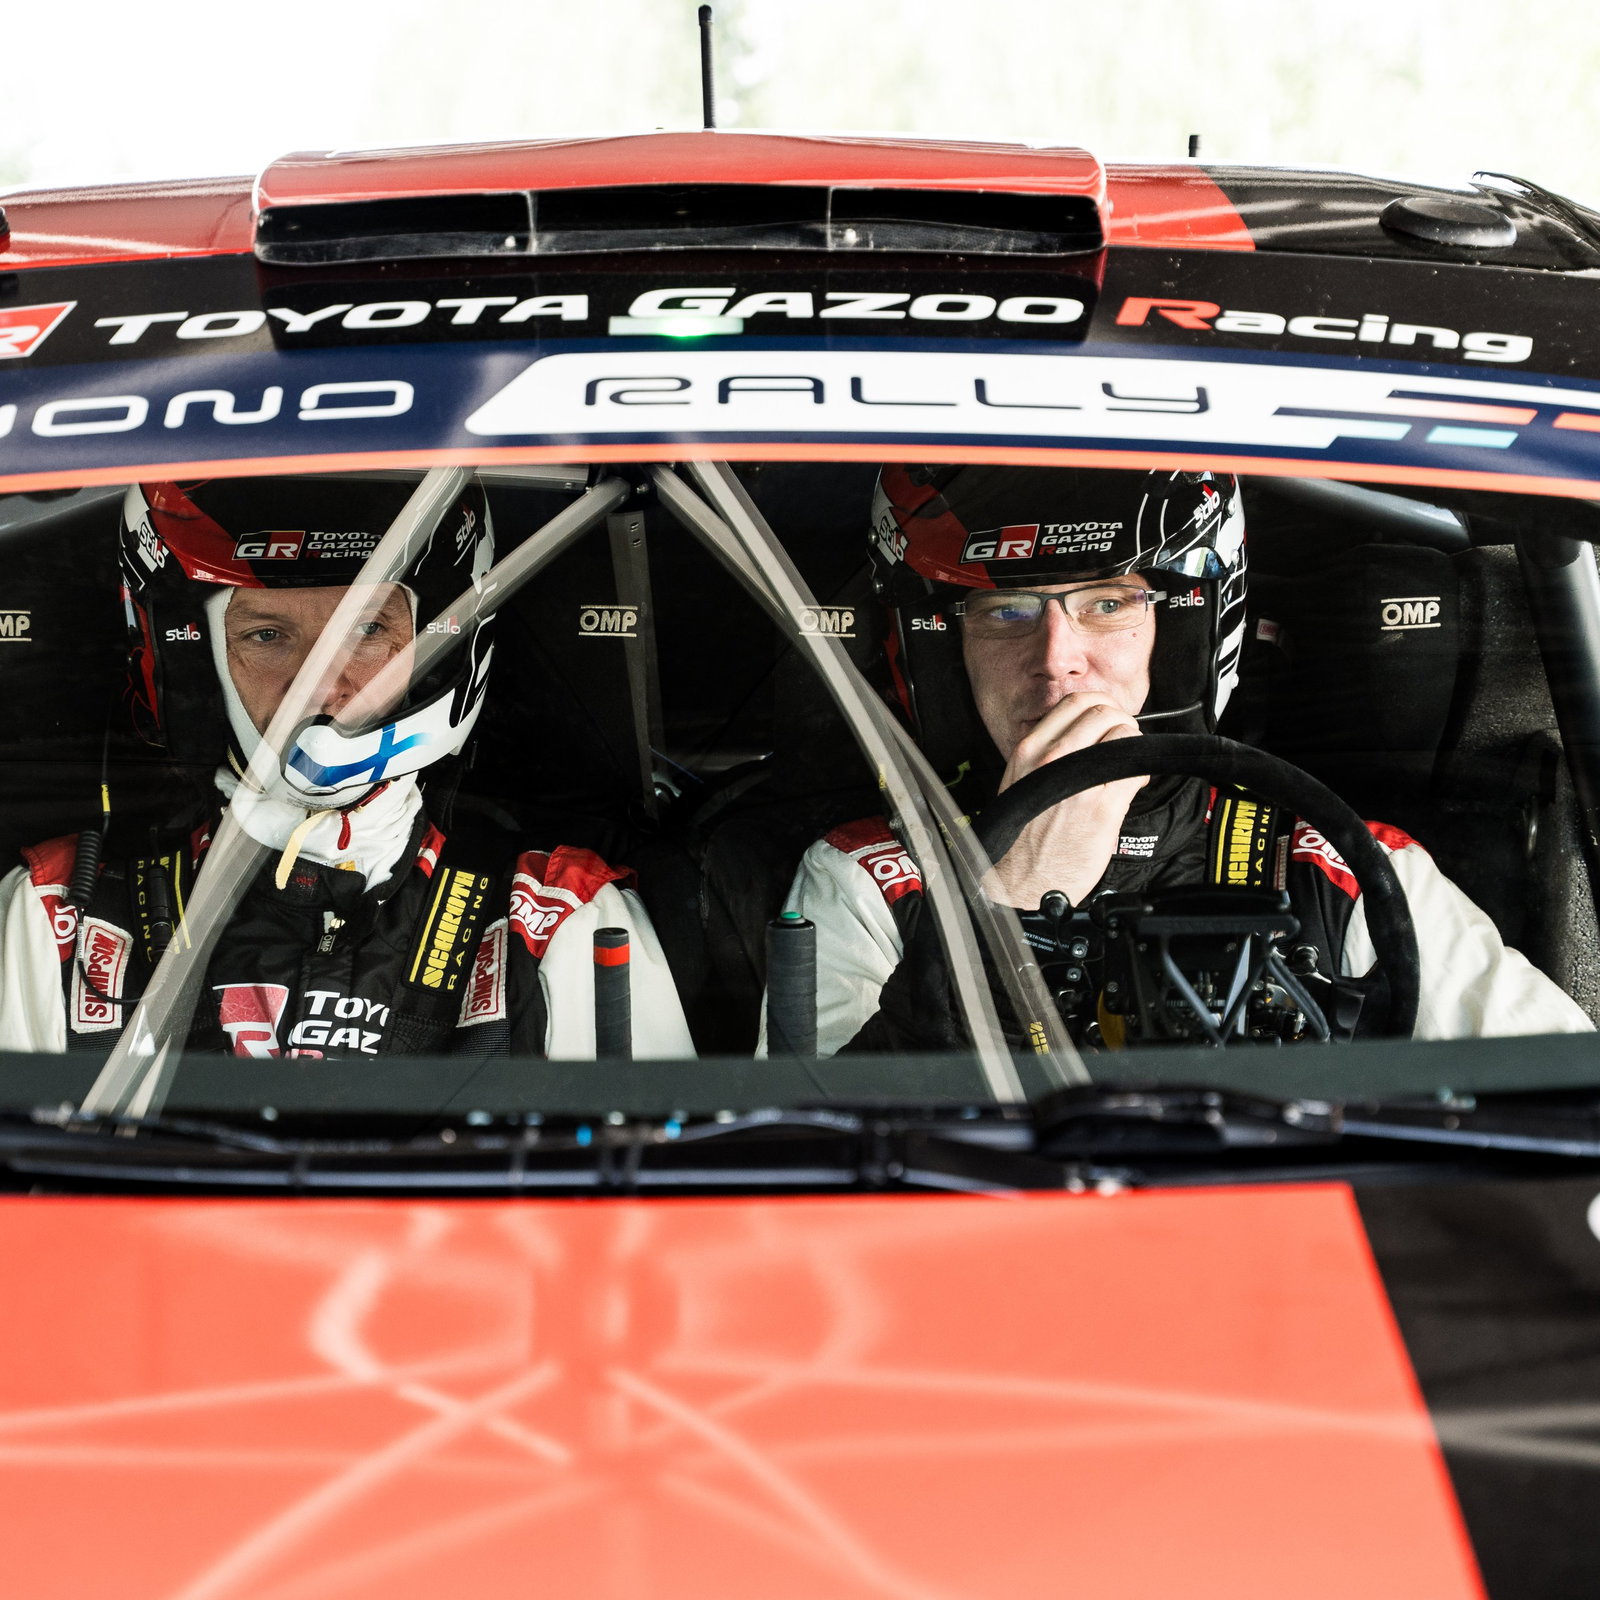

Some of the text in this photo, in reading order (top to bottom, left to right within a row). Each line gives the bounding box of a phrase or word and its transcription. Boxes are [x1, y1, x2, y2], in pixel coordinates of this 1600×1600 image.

[95, 288, 1533, 362] TOYOTA GAZOO Racing
[585, 376, 1209, 414] RALLY
[1041, 531, 1116, 545] GAZOO
[1044, 521, 1123, 535] TOYOTA
[236, 542, 298, 558] GR
[307, 541, 376, 550] GAZOO
[965, 540, 1033, 560] GR
[1039, 541, 1113, 555] Racing
[579, 609, 637, 631] OMP
[800, 610, 855, 632] OMP
[1382, 601, 1440, 625] OMP
[0, 615, 30, 636] MP
[1120, 835, 1159, 843] TOYOTA
[873, 855, 921, 880] OM
[447, 877, 488, 990] RACING
[84, 932, 118, 1018] SIMPSON
[290, 1020, 382, 1055] GAZ
